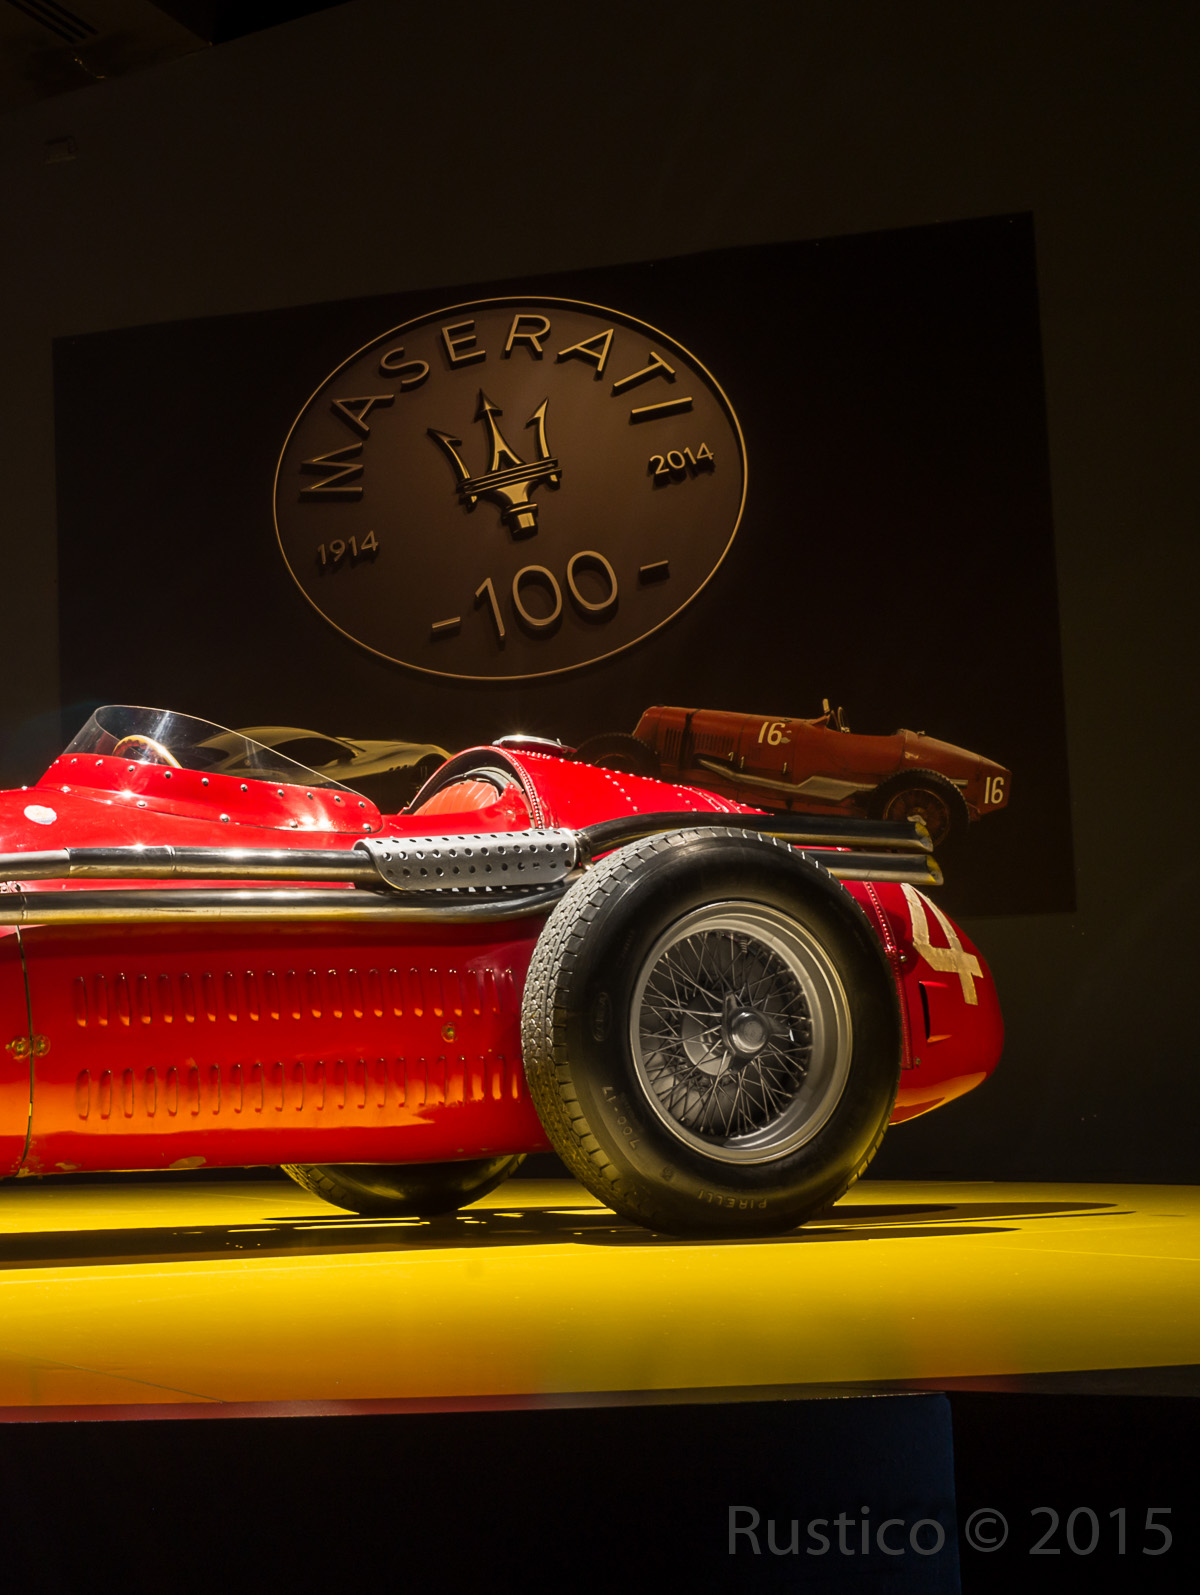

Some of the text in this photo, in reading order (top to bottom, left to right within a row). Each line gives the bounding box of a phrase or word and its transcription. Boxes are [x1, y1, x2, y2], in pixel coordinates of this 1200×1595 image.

[300, 314, 694, 500] MASERATI
[649, 442, 715, 477] 2014
[317, 529, 379, 565] 1914
[758, 721, 784, 746] 16
[984, 776, 1004, 804] 16
[900, 883, 984, 1006] 4
[699, 1190, 767, 1209] PIRELLI
